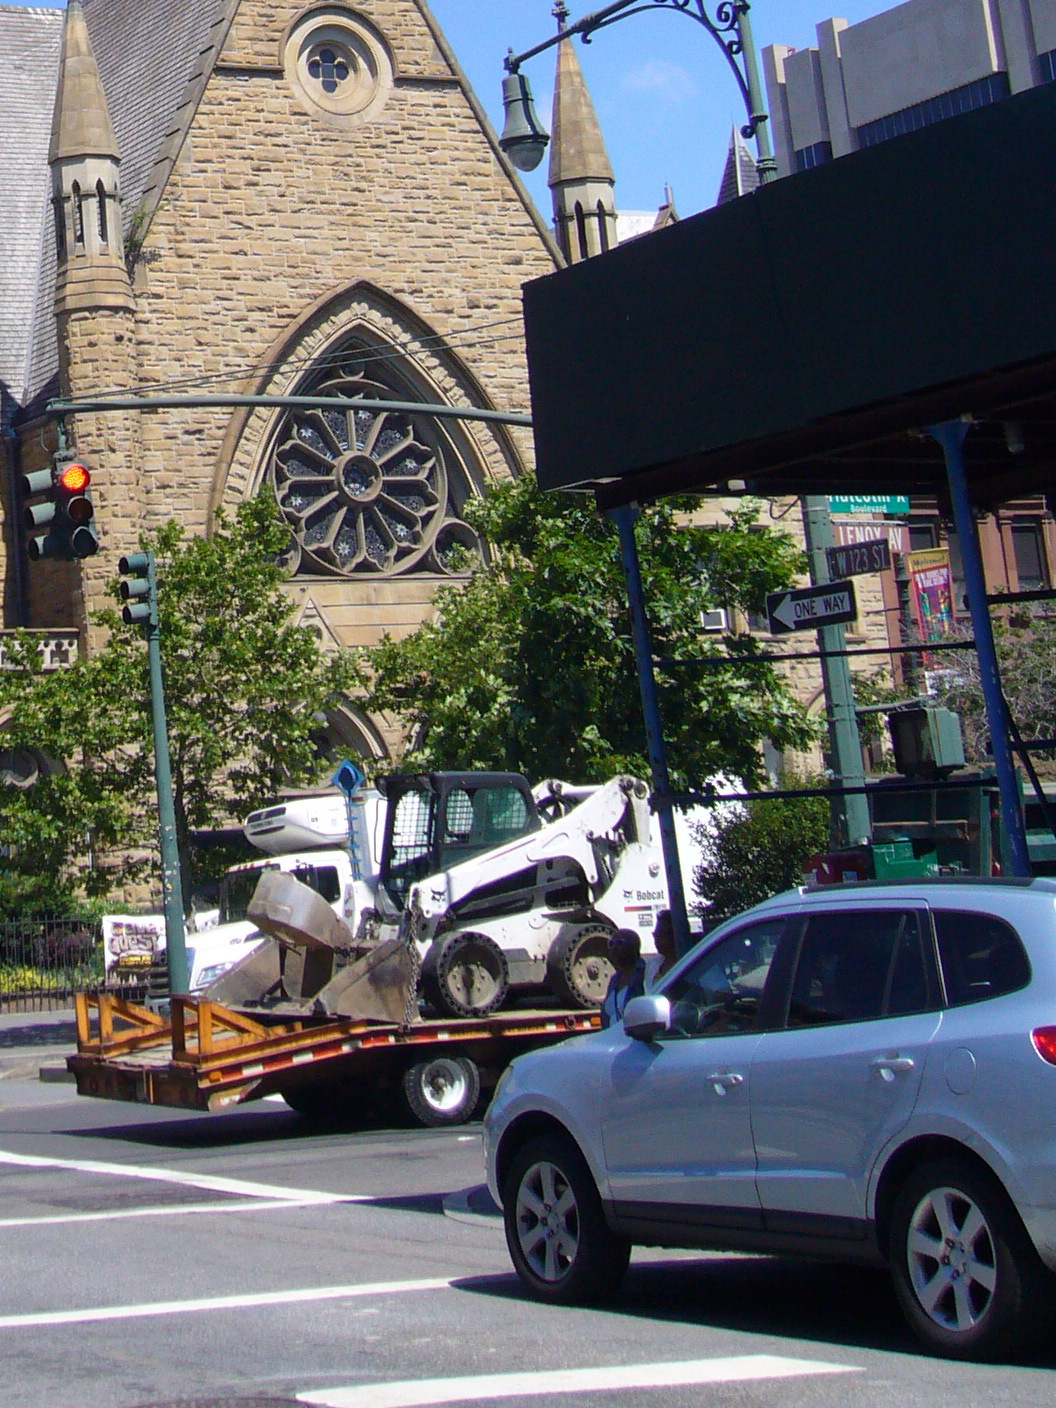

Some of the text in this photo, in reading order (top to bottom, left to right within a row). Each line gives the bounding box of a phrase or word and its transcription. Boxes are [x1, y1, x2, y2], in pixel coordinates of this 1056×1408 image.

[850, 504, 887, 513] Boulevard
[889, 527, 902, 551] AV
[836, 544, 887, 575] W 123 ST
[794, 594, 844, 618] ONE WAY
[636, 889, 665, 901] Bobcat
